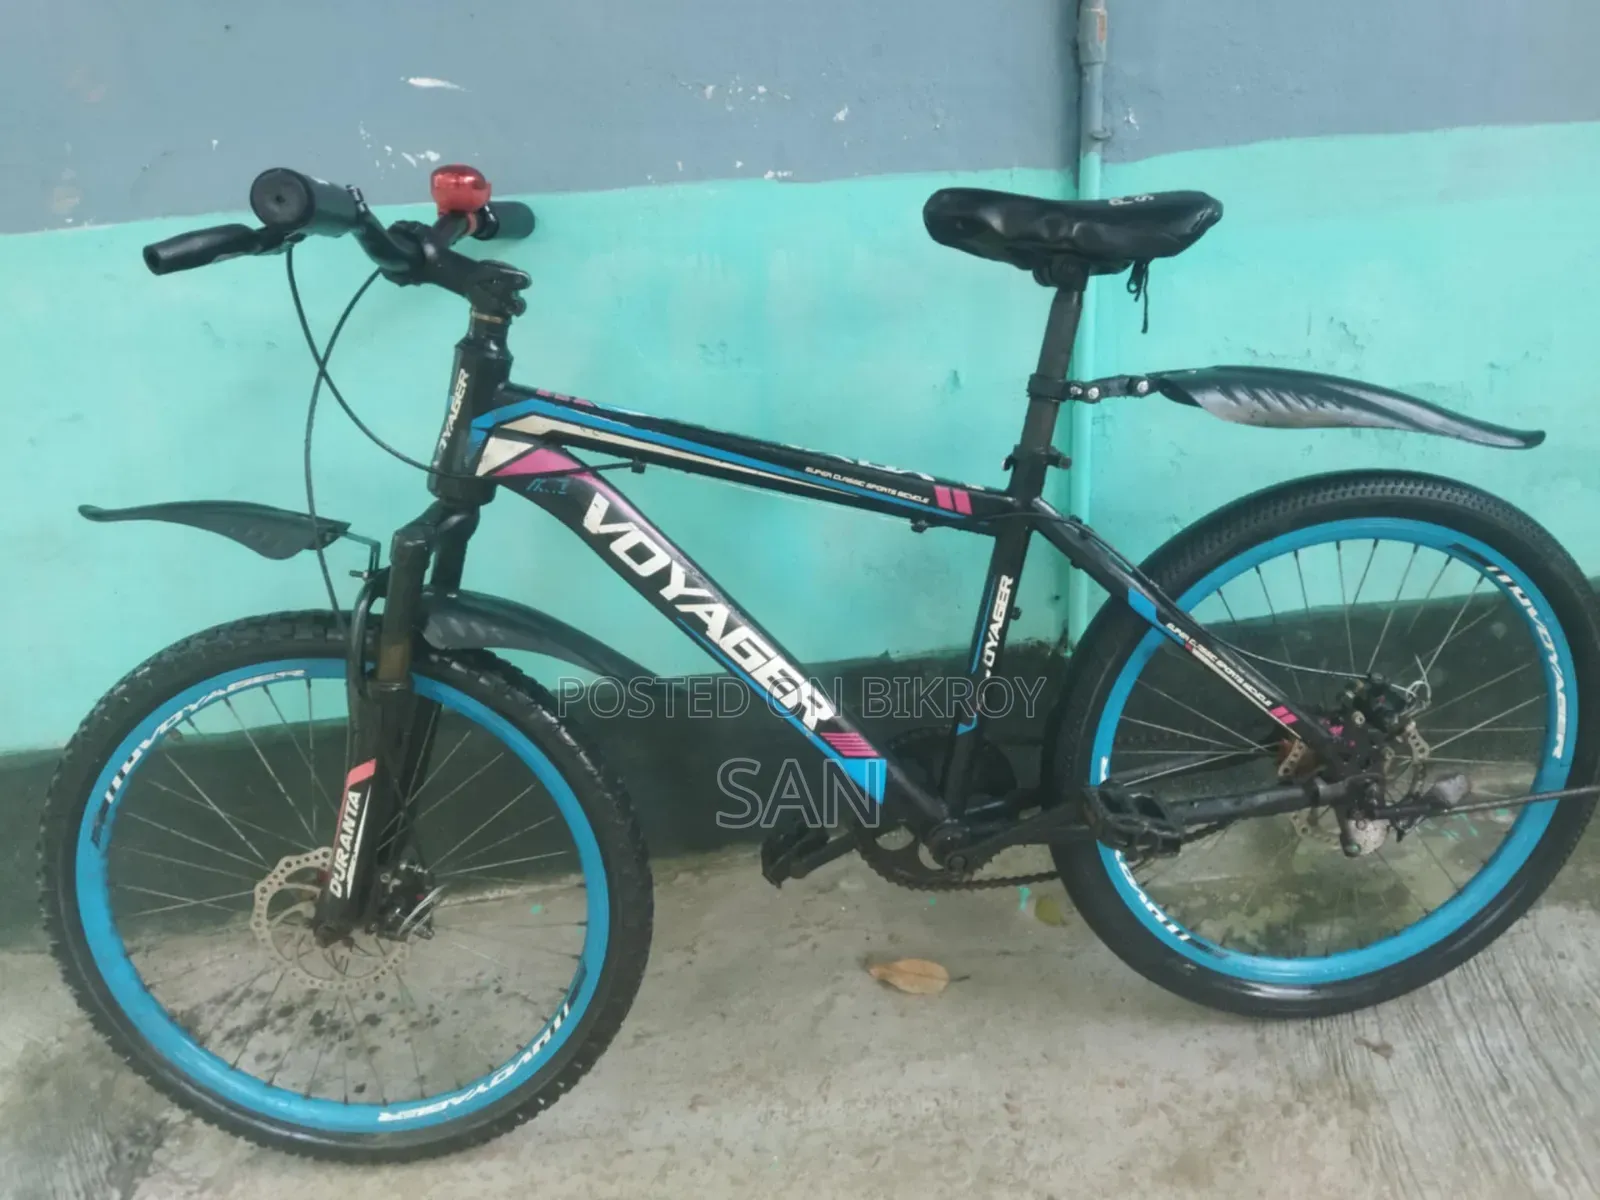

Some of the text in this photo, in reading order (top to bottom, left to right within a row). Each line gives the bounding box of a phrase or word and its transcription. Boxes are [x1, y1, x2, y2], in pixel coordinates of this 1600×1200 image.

[805, 466, 930, 505] SUPER CLASSIC SPORTS BICYCLE
[583, 492, 834, 731] VOYAGER
[329, 790, 362, 899] DURANTA
